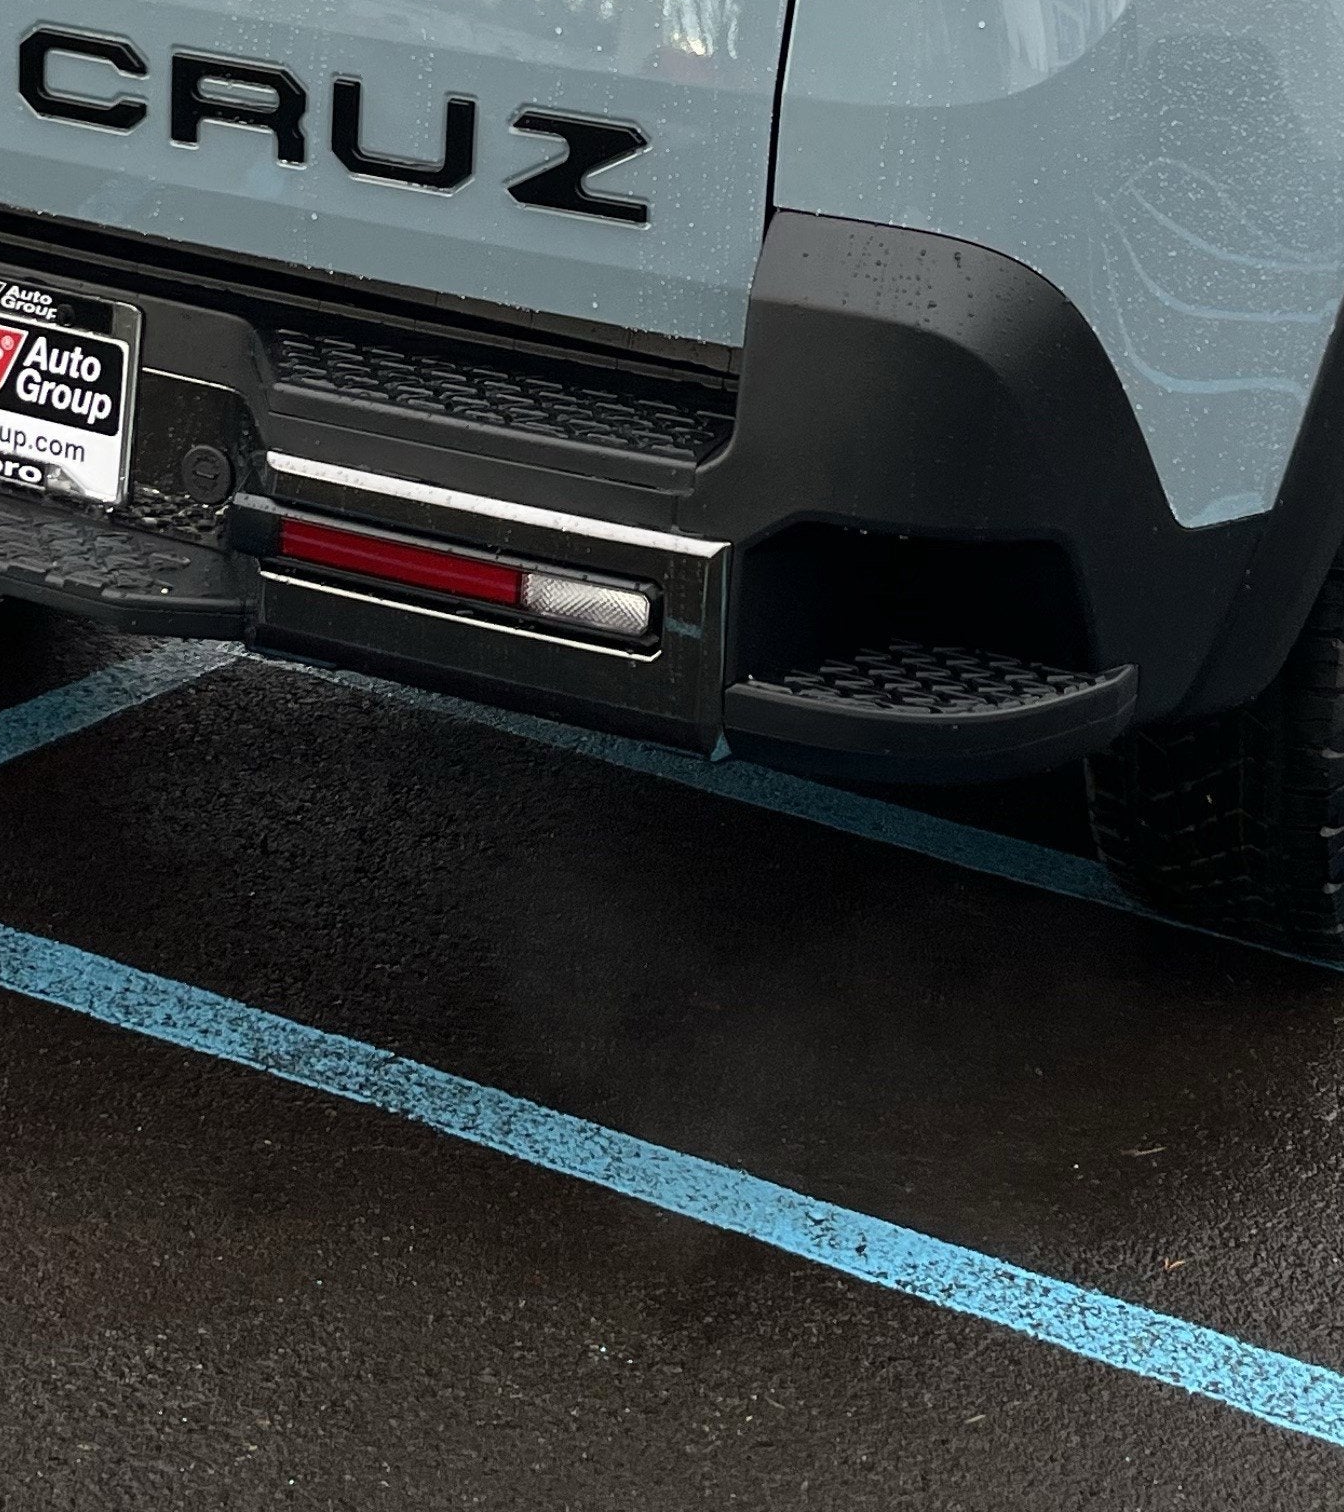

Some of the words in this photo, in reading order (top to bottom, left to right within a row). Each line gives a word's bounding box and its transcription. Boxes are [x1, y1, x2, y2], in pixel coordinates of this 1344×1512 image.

[17, 19, 652, 230] CRUZ
[4, 285, 53, 306] Auto
[22, 336, 102, 382] Auto
[16, 368, 113, 425] Group
